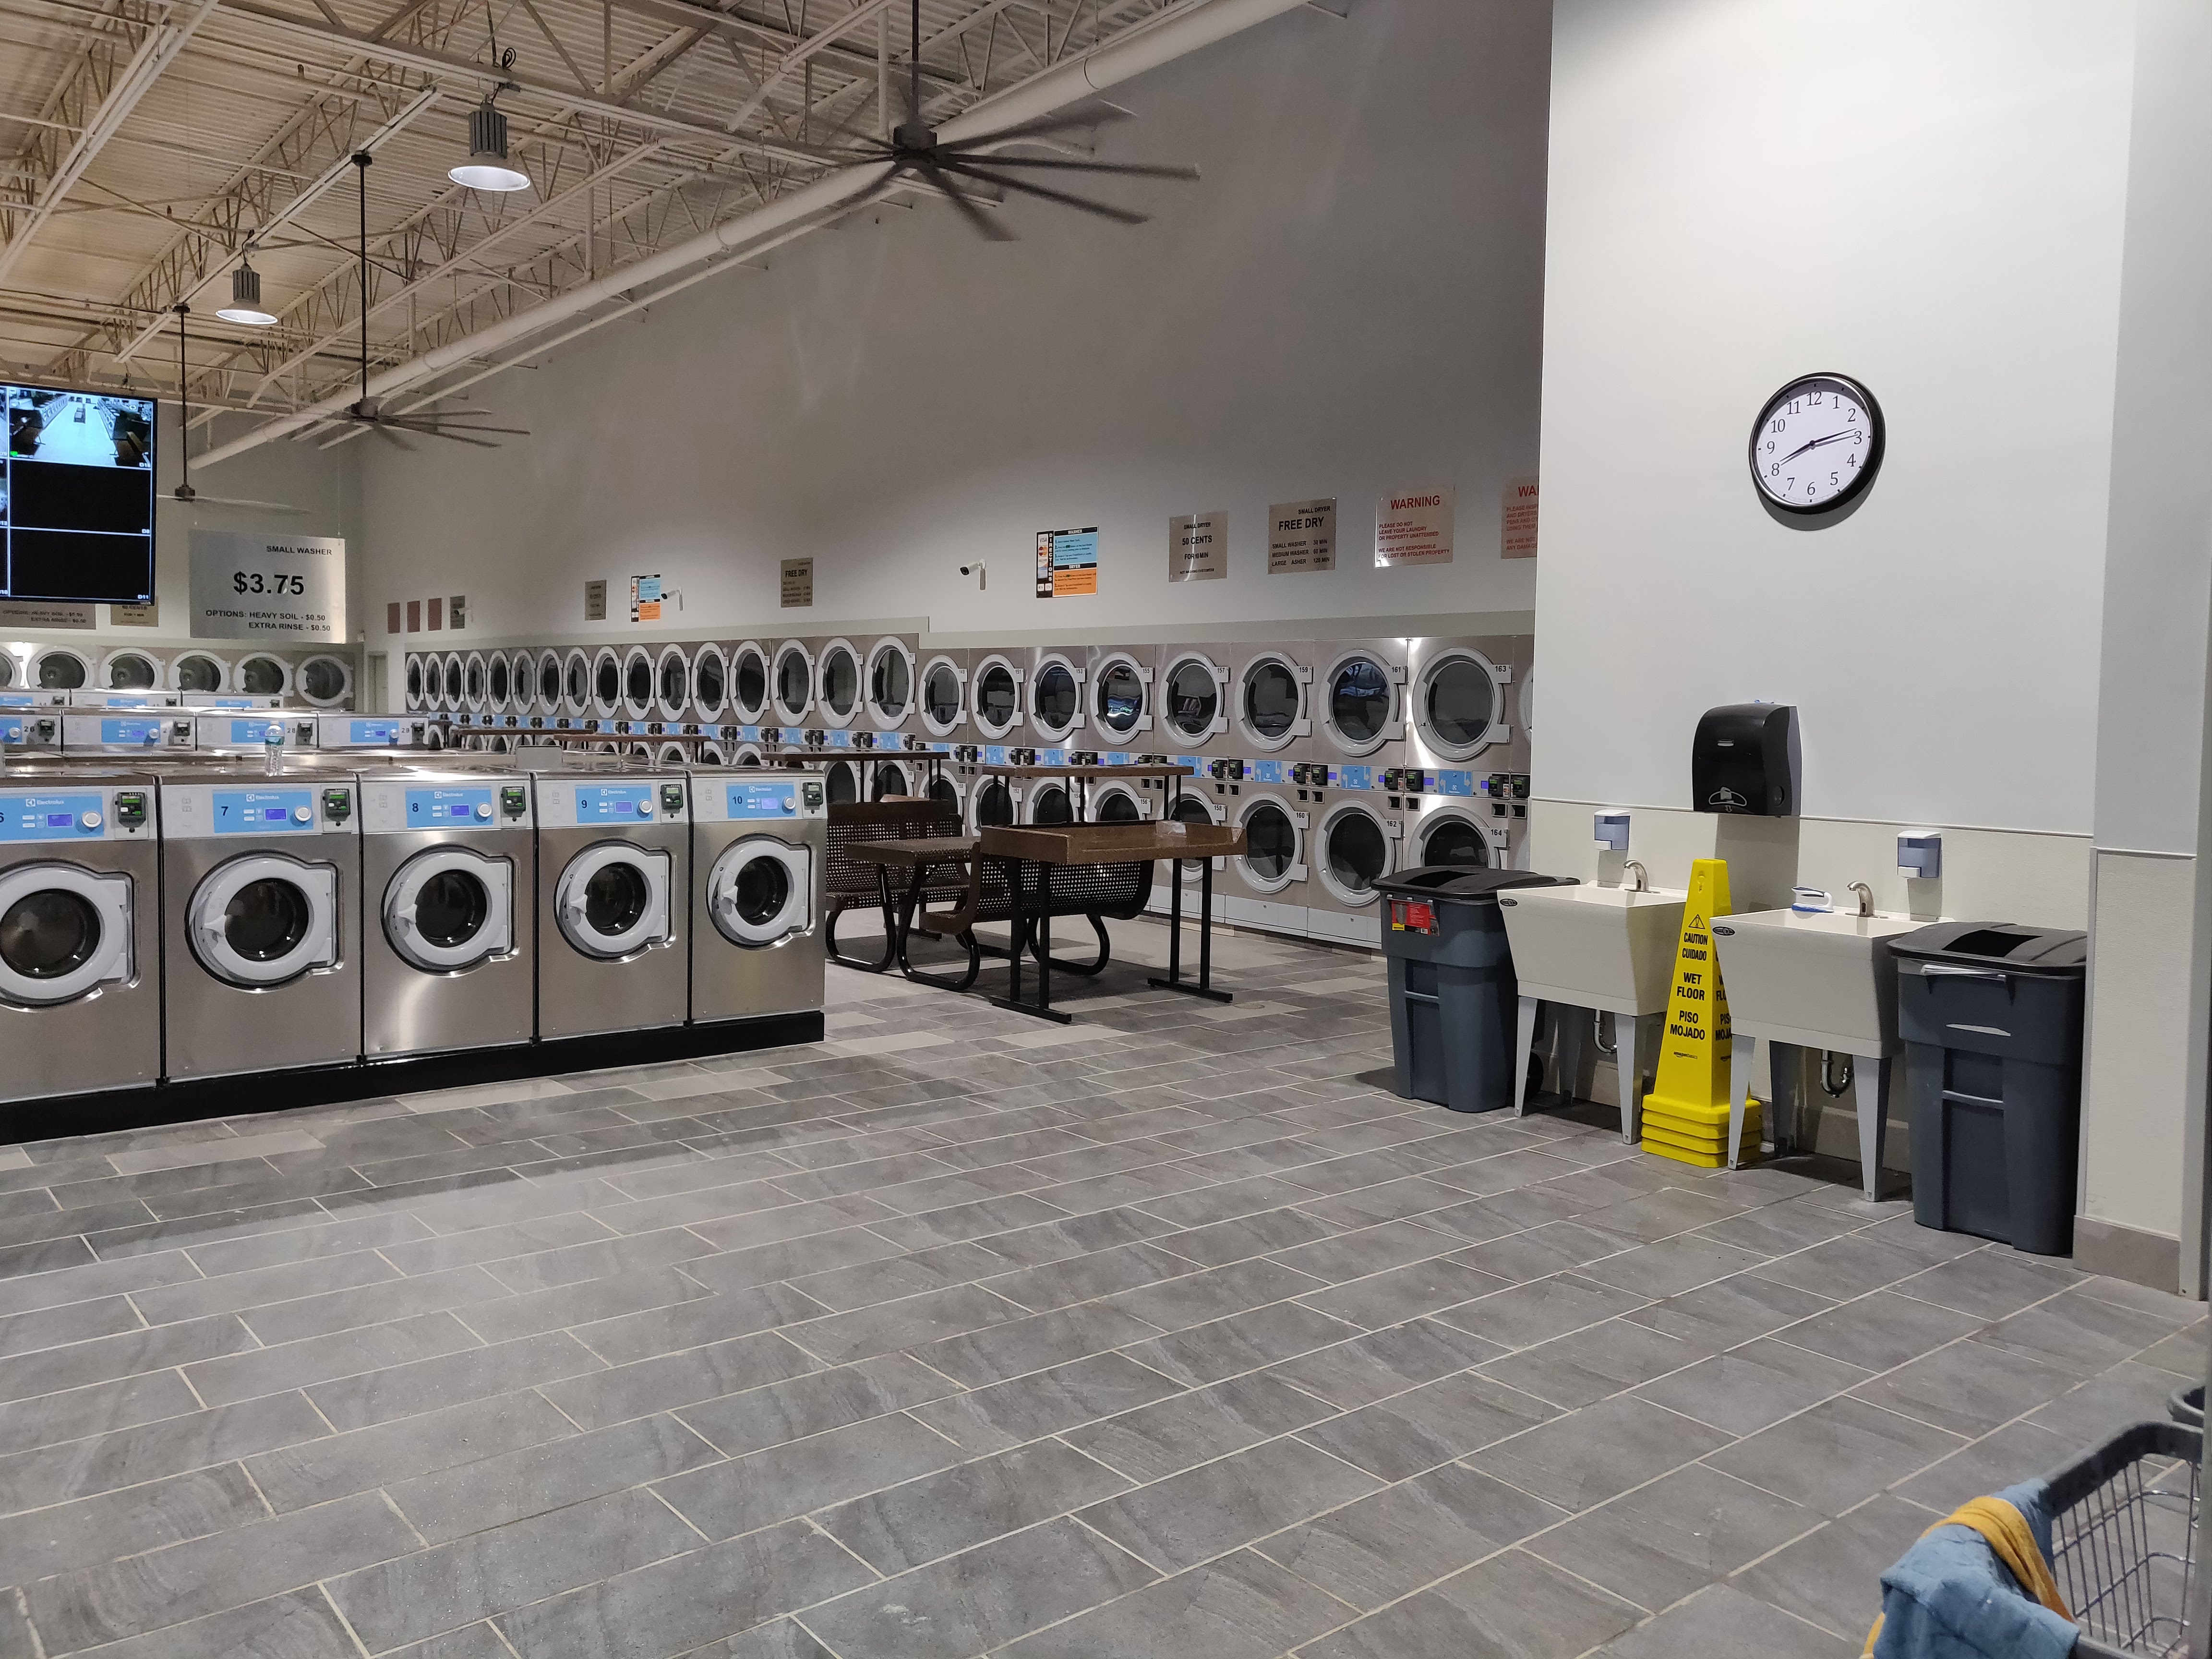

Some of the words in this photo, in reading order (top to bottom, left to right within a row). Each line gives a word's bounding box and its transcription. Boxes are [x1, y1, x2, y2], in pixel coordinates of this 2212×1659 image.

[1806, 391, 1822, 406] 12
[1832, 396, 1840, 409] 1
[1787, 400, 1801, 415] 11
[1847, 408, 1856, 422] 2
[1770, 419, 1785, 433] 10
[1854, 431, 1862, 445] 3
[1767, 441, 1775, 454] 9
[1847, 453, 1856, 467] 4
[1771, 463, 1779, 476] 8
[1787, 477, 1795, 491] 7
[1830, 471, 1838, 485] 5
[1518, 485, 1539, 497] WA
[1807, 481, 1815, 495] 6
[1390, 495, 1440, 510] WARNING
[1279, 519, 1302, 531] FREE
[1305, 517, 1324, 528] DRY
[1191, 535, 1213, 544] CENTS
[266, 545, 295, 554] SMALL
[297, 547, 332, 555] WASHER
[233, 571, 304, 595] $3.75
[206, 610, 247, 618] OPTIONS:
[250, 612, 277, 620] HEAVY
[581, 800, 588, 808] 9
[732, 796, 742, 805] 10
[221, 806, 228, 816] 7
[412, 803, 419, 812] 8
[1684, 932, 1708, 946] CAUTION
[1682, 948, 1707, 961] CUIDADO
[1683, 972, 1702, 985] WET
[1677, 986, 1705, 1001] FLOOR
[1679, 1010, 1698, 1023] PISO
[1720, 1013, 1731, 1025] PIS
[1670, 1024, 1705, 1040] MOJADO
